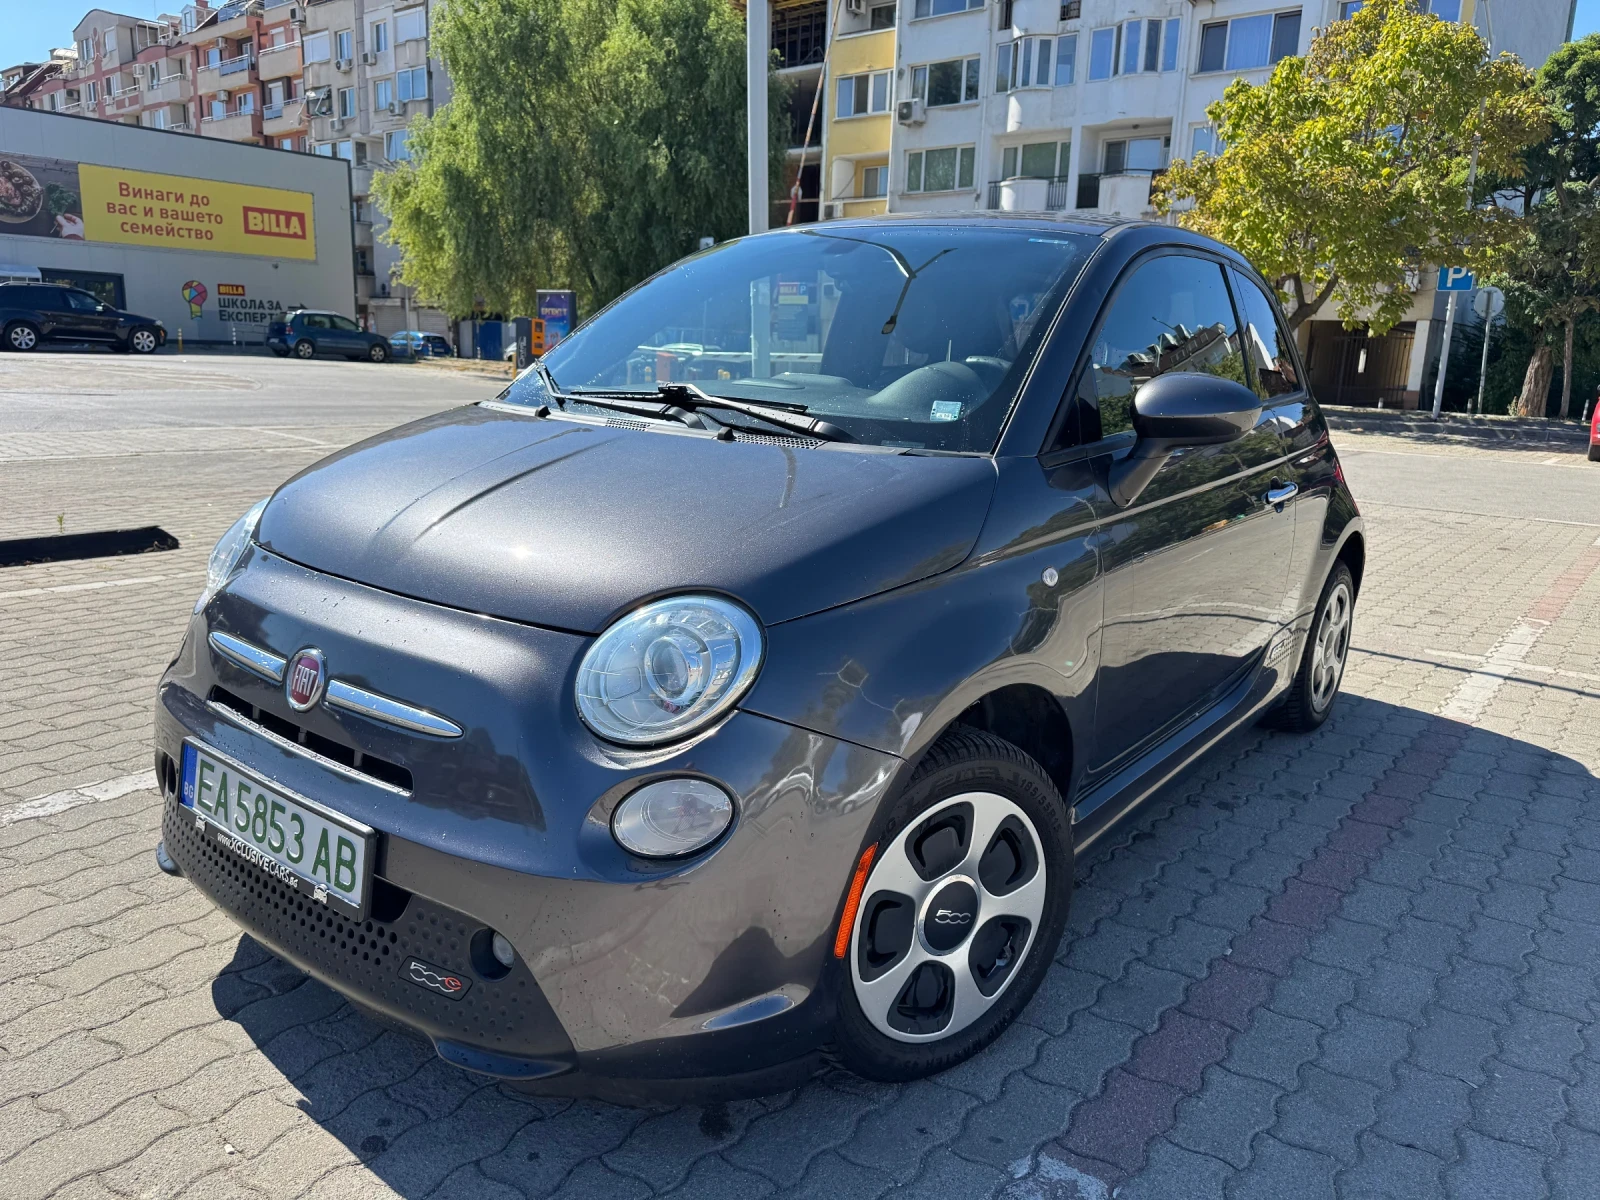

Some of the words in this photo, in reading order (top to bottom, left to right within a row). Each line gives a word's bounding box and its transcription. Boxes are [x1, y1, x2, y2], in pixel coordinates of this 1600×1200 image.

[118, 182, 185, 204] Винаги
[190, 193, 210, 207] до
[106, 202, 137, 216] вас
[143, 206, 154, 218] и
[159, 209, 224, 225] вашето
[247, 211, 303, 236] BILLA
[120, 221, 214, 241] семейство
[1446, 265, 1467, 287] P
[219, 285, 244, 295] BILLA
[218, 297, 266, 311] ШКОЛА
[267, 300, 282, 311] ЗА
[218, 309, 279, 323] ЕКСПЕРТ
[292, 664, 318, 697] FIAT
[183, 781, 194, 799] BG
[197, 759, 229, 823] EA
[234, 781, 305, 865] 5853
[311, 827, 357, 893] AB
[934, 909, 971, 925] 500
